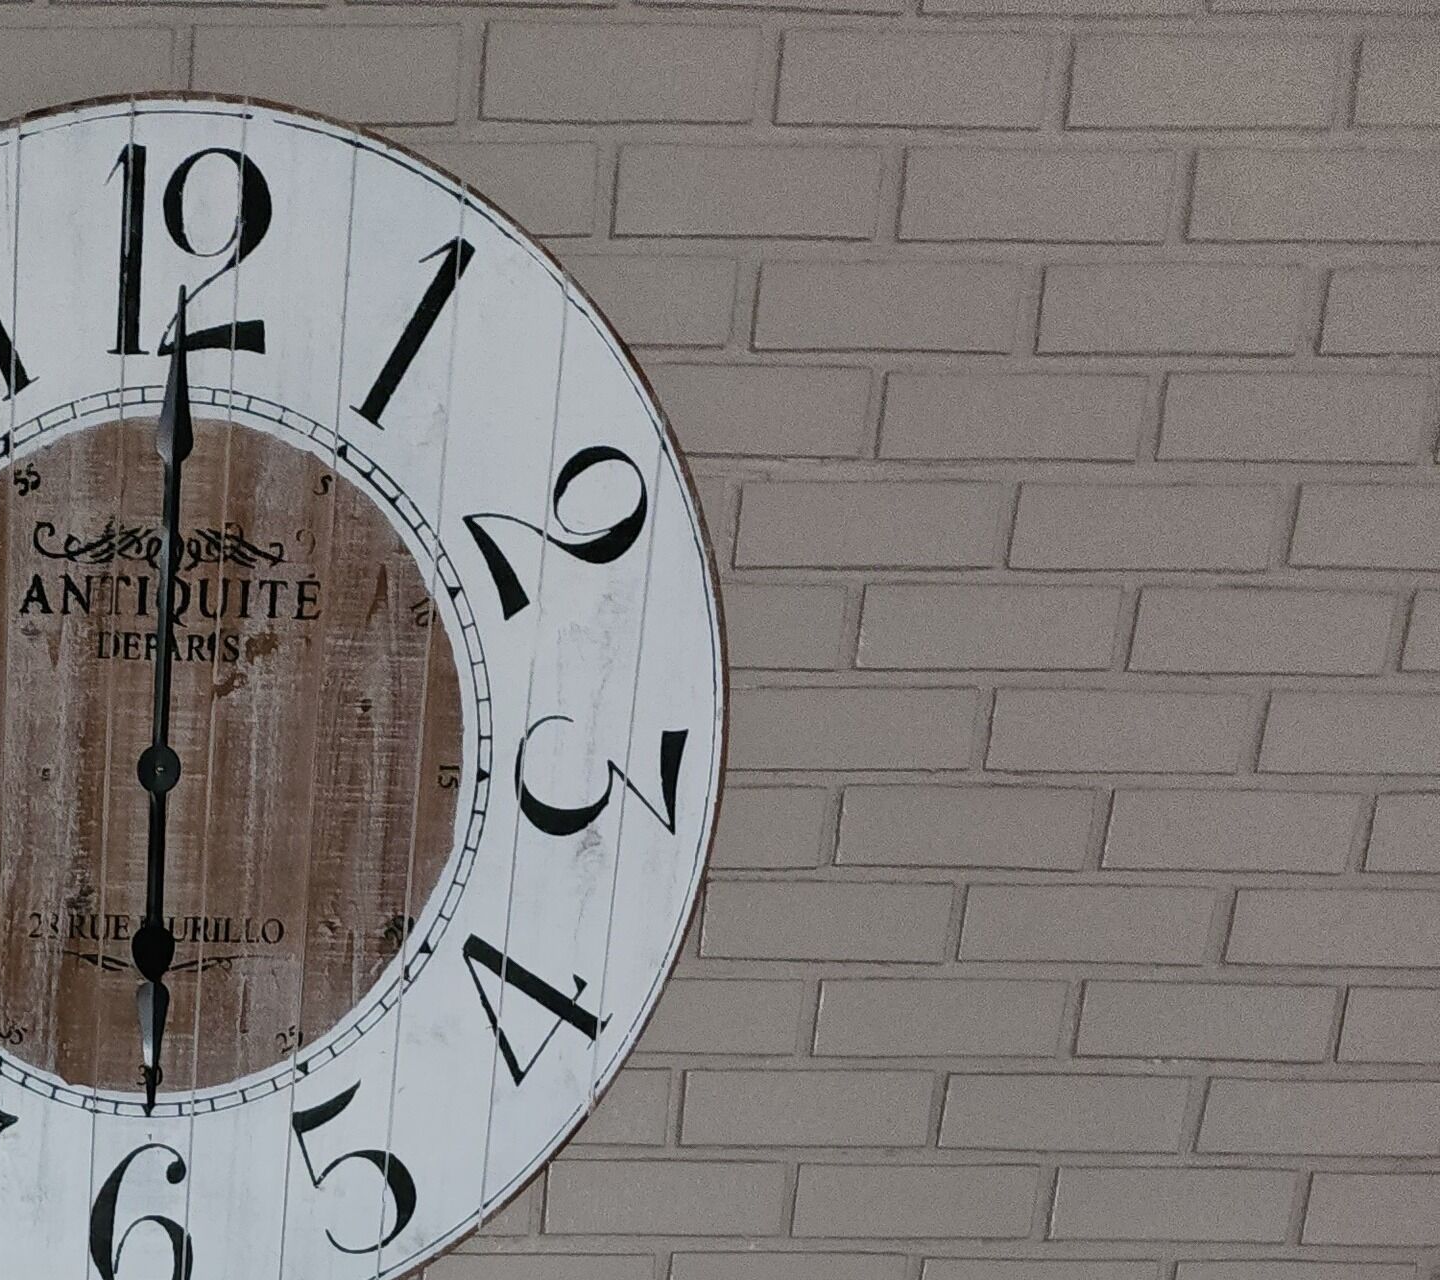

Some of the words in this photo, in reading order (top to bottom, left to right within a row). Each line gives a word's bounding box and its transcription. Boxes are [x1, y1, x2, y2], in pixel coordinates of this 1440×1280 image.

[105, 144, 272, 357] 12
[350, 236, 475, 430] 1
[463, 445, 648, 619] 2
[515, 714, 689, 836] 3
[69, 914, 130, 940] RUE
[143, 915, 285, 944] URILLO
[463, 934, 613, 1087] 4
[291, 1081, 417, 1254] 5
